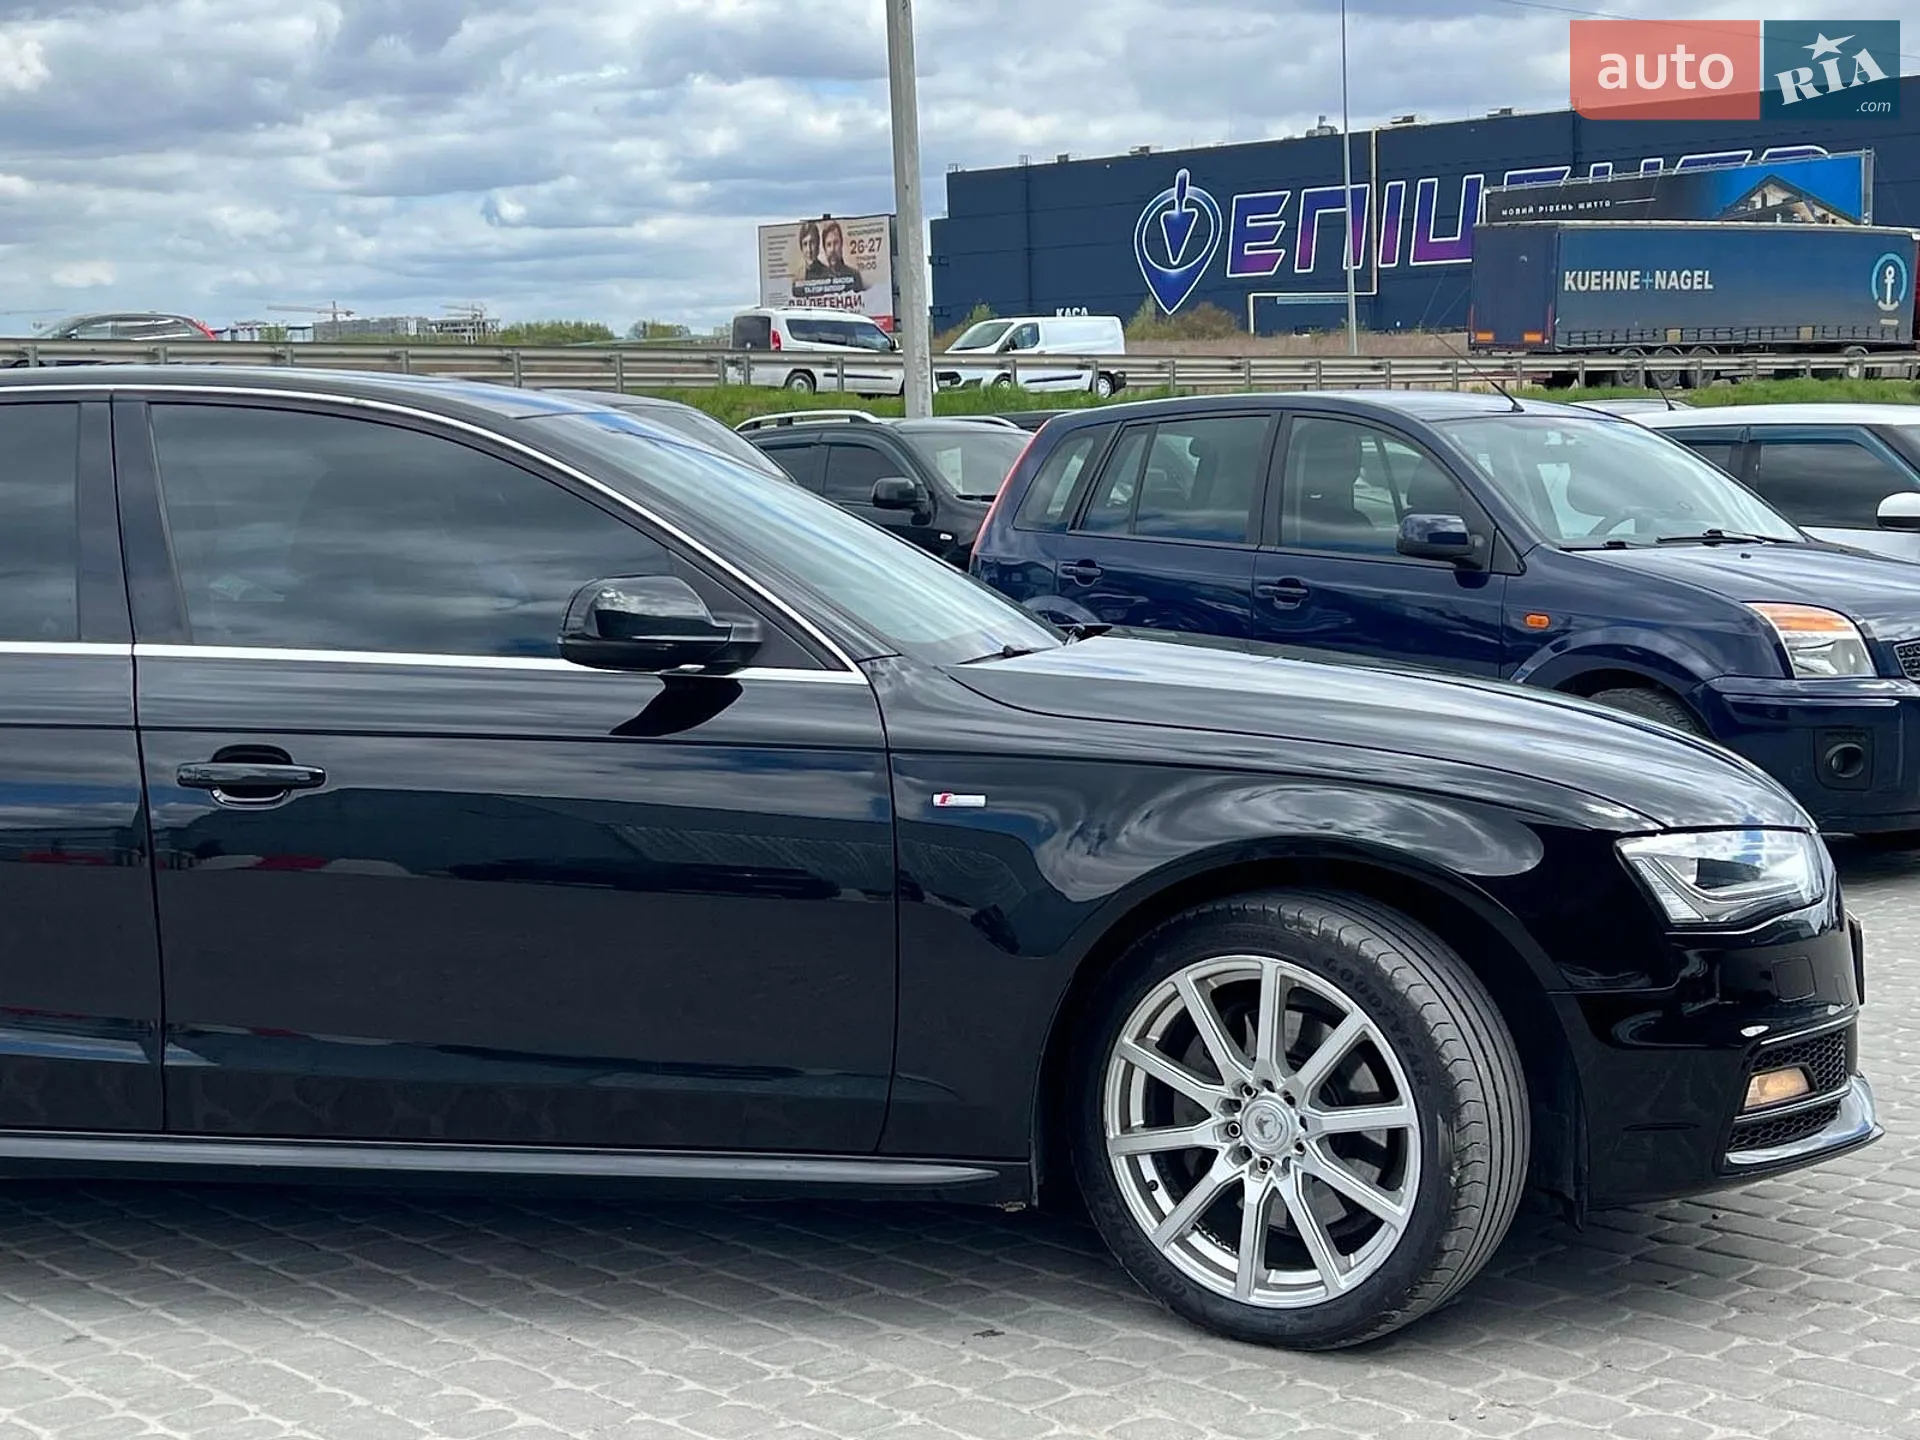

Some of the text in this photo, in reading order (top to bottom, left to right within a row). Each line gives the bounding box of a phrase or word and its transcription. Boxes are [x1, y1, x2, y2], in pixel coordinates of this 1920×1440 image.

[1538, 203, 1574, 213] РІВЕНЬ
[850, 237, 882, 255] 26-27
[1563, 269, 1714, 292] KUEHNE+NAGEL
[1056, 307, 1088, 317] КАСА
